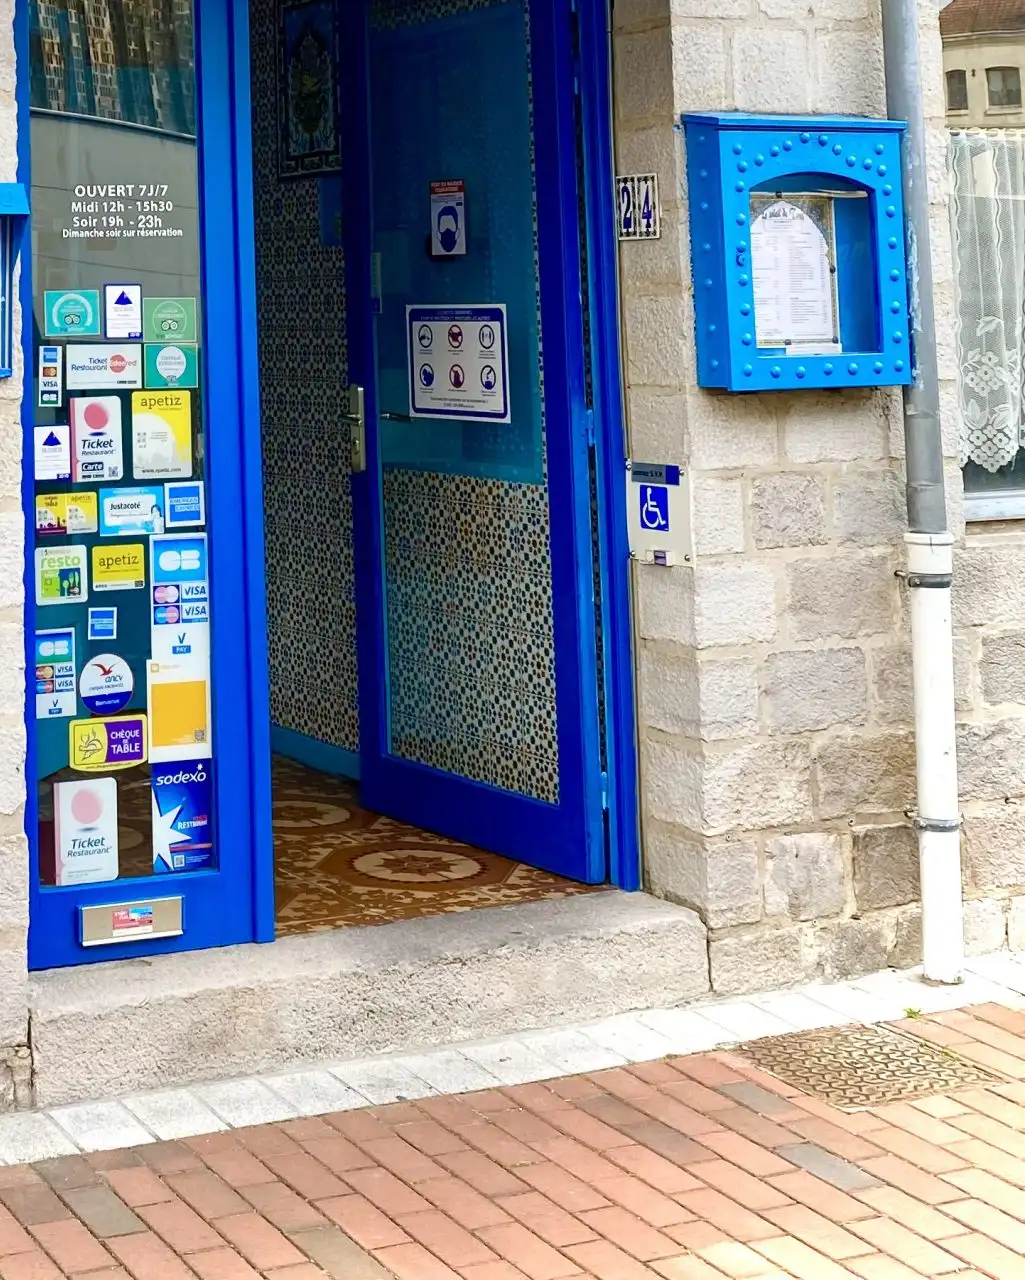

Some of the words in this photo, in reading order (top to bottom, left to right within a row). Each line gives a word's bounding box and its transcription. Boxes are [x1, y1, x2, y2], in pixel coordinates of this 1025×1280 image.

[74, 184, 134, 197] OUVERT
[139, 184, 169, 197] 7J/7
[71, 200, 99, 213] Midi
[102, 200, 125, 213] 12h
[135, 200, 174, 212] 15h30
[621, 184, 653, 229] 24
[72, 215, 98, 228] Soir
[101, 216, 124, 227] 19h
[137, 215, 162, 228] 23h
[62, 227, 104, 238] Dimanche
[105, 227, 122, 237] soir
[122, 229, 135, 237] sur
[42, 380, 58, 388] VISA
[140, 394, 182, 410] apetiz
[81, 439, 114, 450] Ticket
[81, 462, 104, 471] Carte
[40, 554, 81, 569] resto
[98, 553, 140, 570] apetiz
[184, 585, 207, 596] VISA
[184, 605, 207, 616] VISA
[57, 665, 73, 673] VISA
[57, 680, 74, 688] VISA
[110, 728, 141, 740] CHÈQUE
[110, 742, 141, 755] TABLE
[156, 770, 207, 786] sodexo
[71, 836, 106, 850] Ticket
[67, 847, 111, 858] Restaurant
